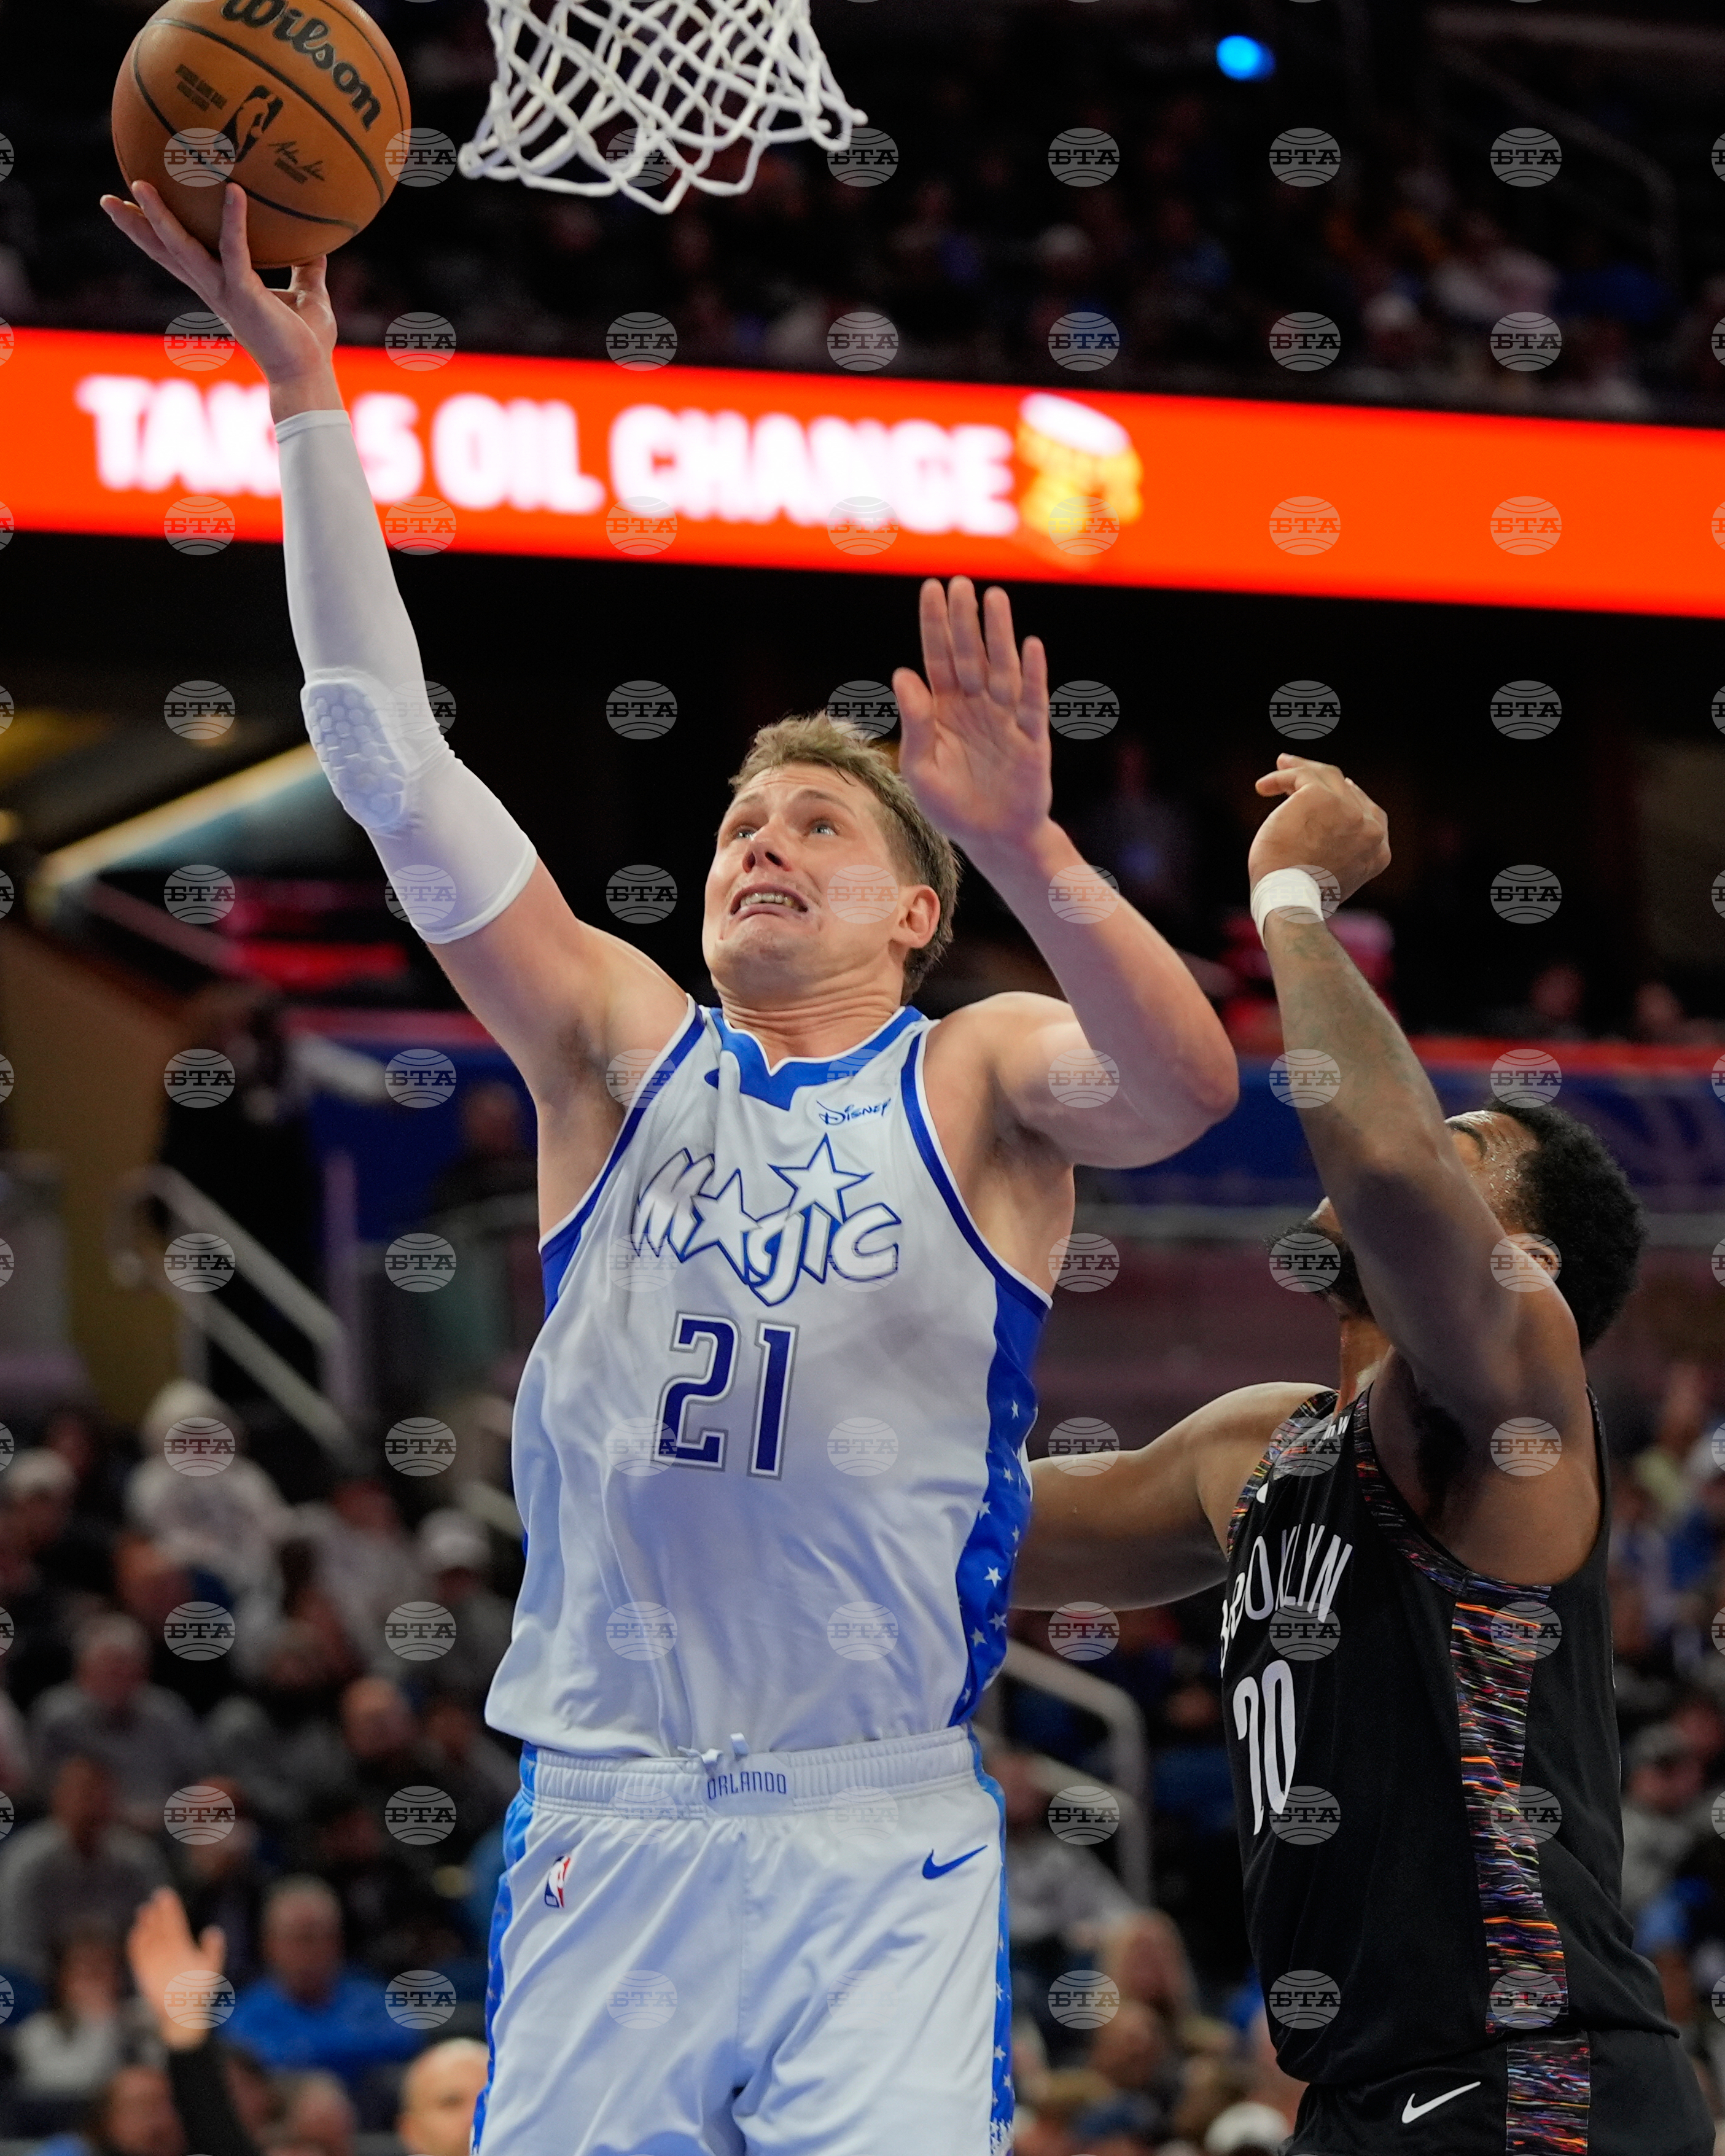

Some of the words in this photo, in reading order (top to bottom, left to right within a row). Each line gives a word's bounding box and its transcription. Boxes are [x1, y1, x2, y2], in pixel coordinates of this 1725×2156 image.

[220, 0, 381, 133] Wilson
[75, 374, 282, 499] TAK
[430, 393, 605, 515] OIL
[609, 403, 1019, 537] CHANGE
[651, 1310, 800, 1481] 21
[707, 1771, 787, 1800] ORLANDO
